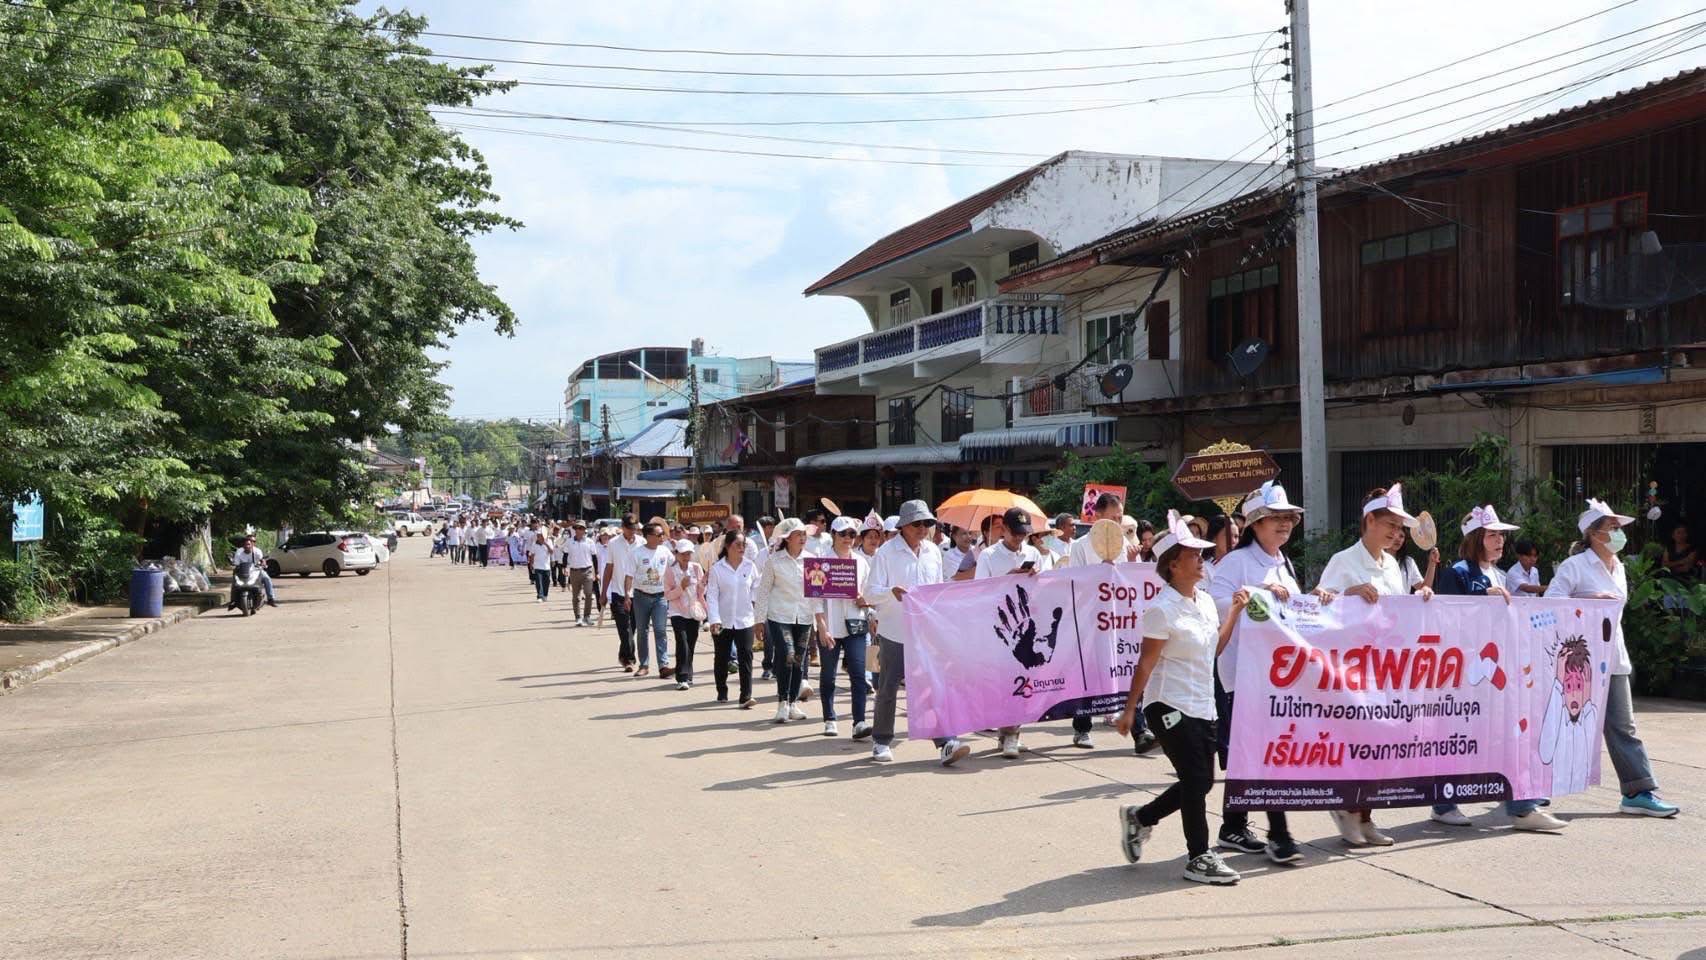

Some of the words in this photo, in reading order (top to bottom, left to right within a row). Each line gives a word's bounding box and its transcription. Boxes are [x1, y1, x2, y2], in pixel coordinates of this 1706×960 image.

[1207, 471, 1239, 482] SUBDISTRICT
[1098, 582, 1137, 608] Stop
[1144, 581, 1162, 601] Dr
[1096, 611, 1137, 631] Start
[1270, 635, 1464, 692] ยาเสพติด
[1033, 677, 1065, 690] มิถุนายน
[1270, 694, 1480, 722] ไม่ใช่ทางออกของปัญหาแต่เป็นจุด
[1263, 723, 1344, 768] เริ่มต้น
[1349, 733, 1478, 762] ของการทำลายชีวิต
[1455, 781, 1504, 797] 038211234
